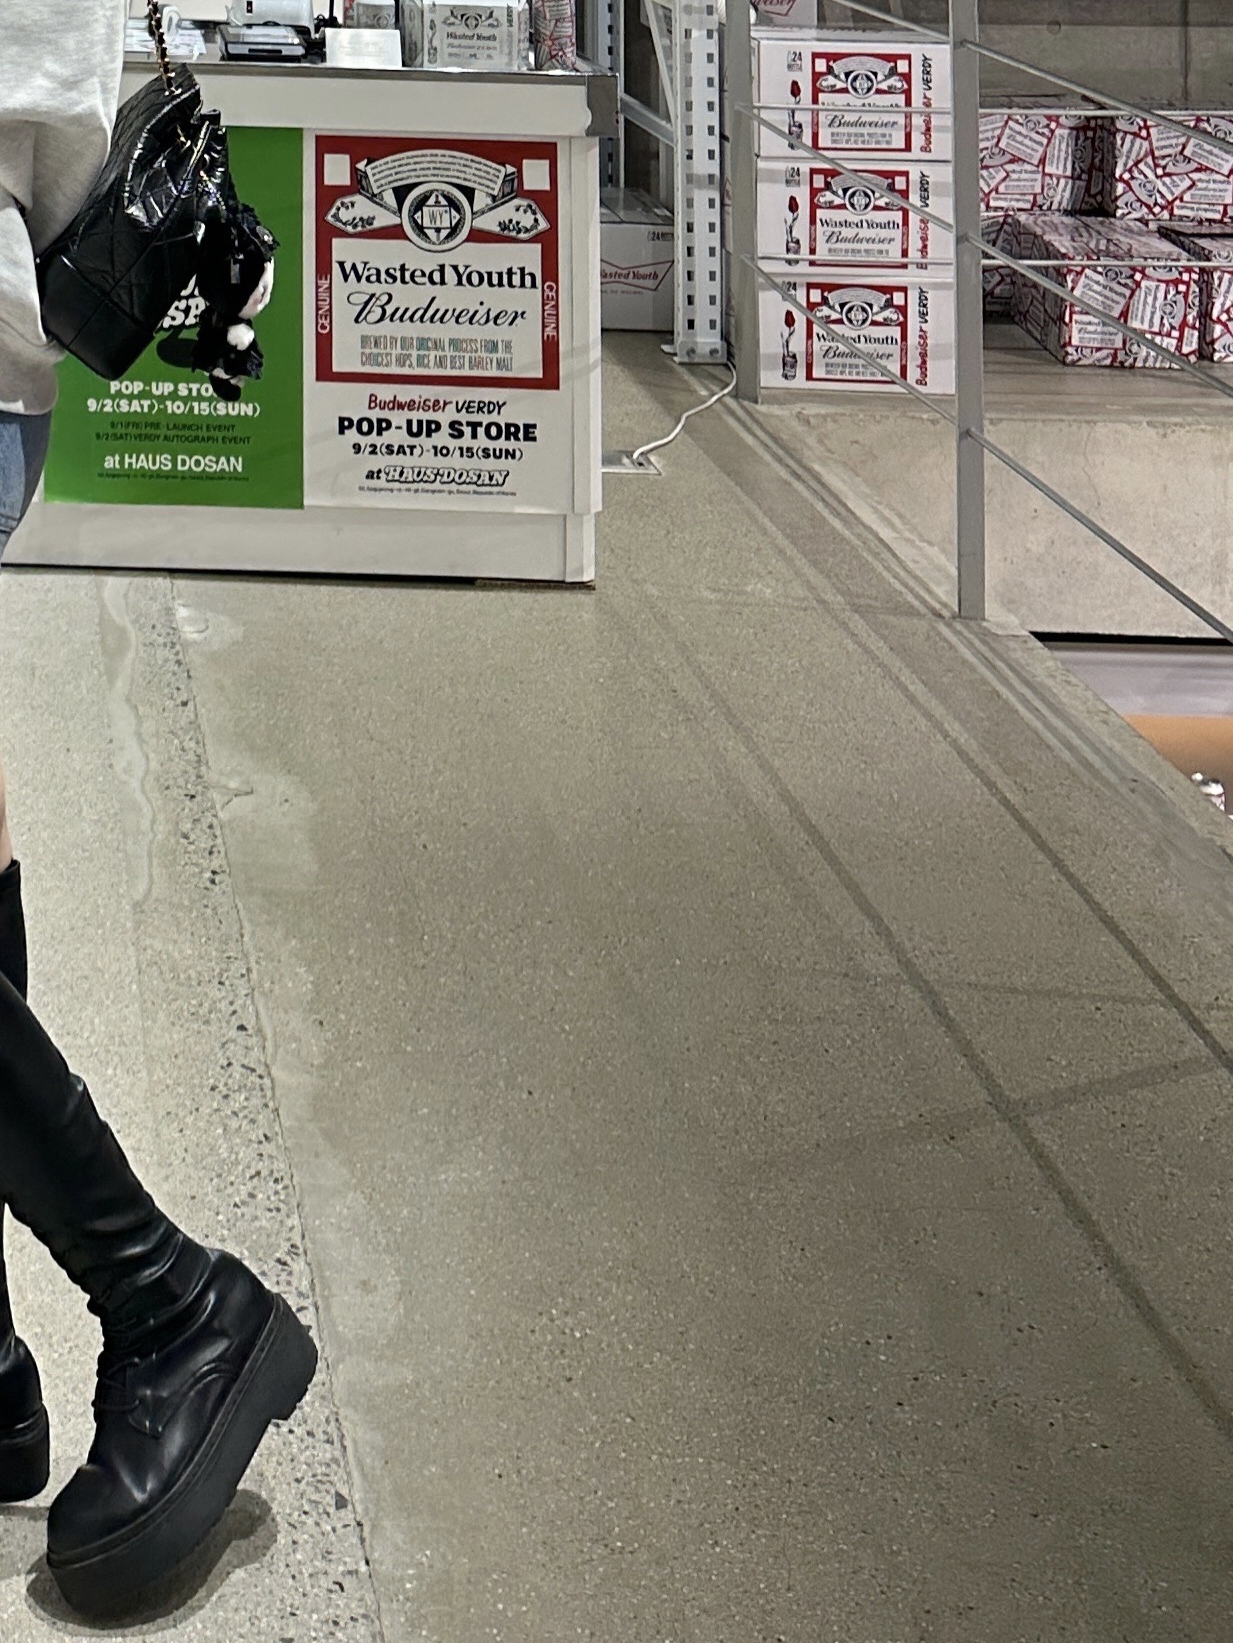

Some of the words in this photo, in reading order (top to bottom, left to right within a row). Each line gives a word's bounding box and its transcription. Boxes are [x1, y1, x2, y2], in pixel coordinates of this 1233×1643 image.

[825, 114, 899, 129] Budweiser
[819, 217, 863, 229] Wasted
[864, 219, 900, 230] Youth
[823, 230, 895, 245] Budweiser
[335, 260, 447, 287] Wasted
[449, 264, 539, 290] Youth
[317, 274, 331, 334] GENUINE
[346, 291, 527, 327] Budweiser
[543, 281, 558, 342] GENUINE
[360, 334, 389, 351] BREWED
[390, 335, 399, 352] BY
[400, 336, 415, 352] OUR
[416, 336, 447, 353] ORIGINAL
[448, 337, 479, 354] PROCESS
[480, 338, 499, 354] FROM
[500, 339, 514, 355] THE
[863, 333, 899, 346] Youth
[360, 352, 393, 368] CHOICEST
[416, 354, 431, 369] RICE
[433, 354, 448, 370] AND
[449, 355, 466, 370] BEST
[468, 356, 494, 372] BARLEY
[495, 357, 514, 372] MALT
[110, 381, 174, 397] POP-UP
[177, 382, 216, 398] STO
[368, 393, 453, 413] Budweiser
[455, 400, 507, 416] VERDY
[206, 423, 236, 433] EVENT
[338, 416, 442, 439] POP-UP
[448, 421, 537, 443] STORE
[133, 432, 161, 443] VERDY
[162, 433, 219, 444] AUTOGRAPH
[221, 434, 252, 445] EVENT
[104, 455, 121, 470] at
[124, 453, 172, 471] HAUS
[177, 454, 243, 473] DOSAN
[365, 467, 383, 480] at
[383, 464, 440, 484] HAUS
[438, 467, 510, 487] DOSAN
